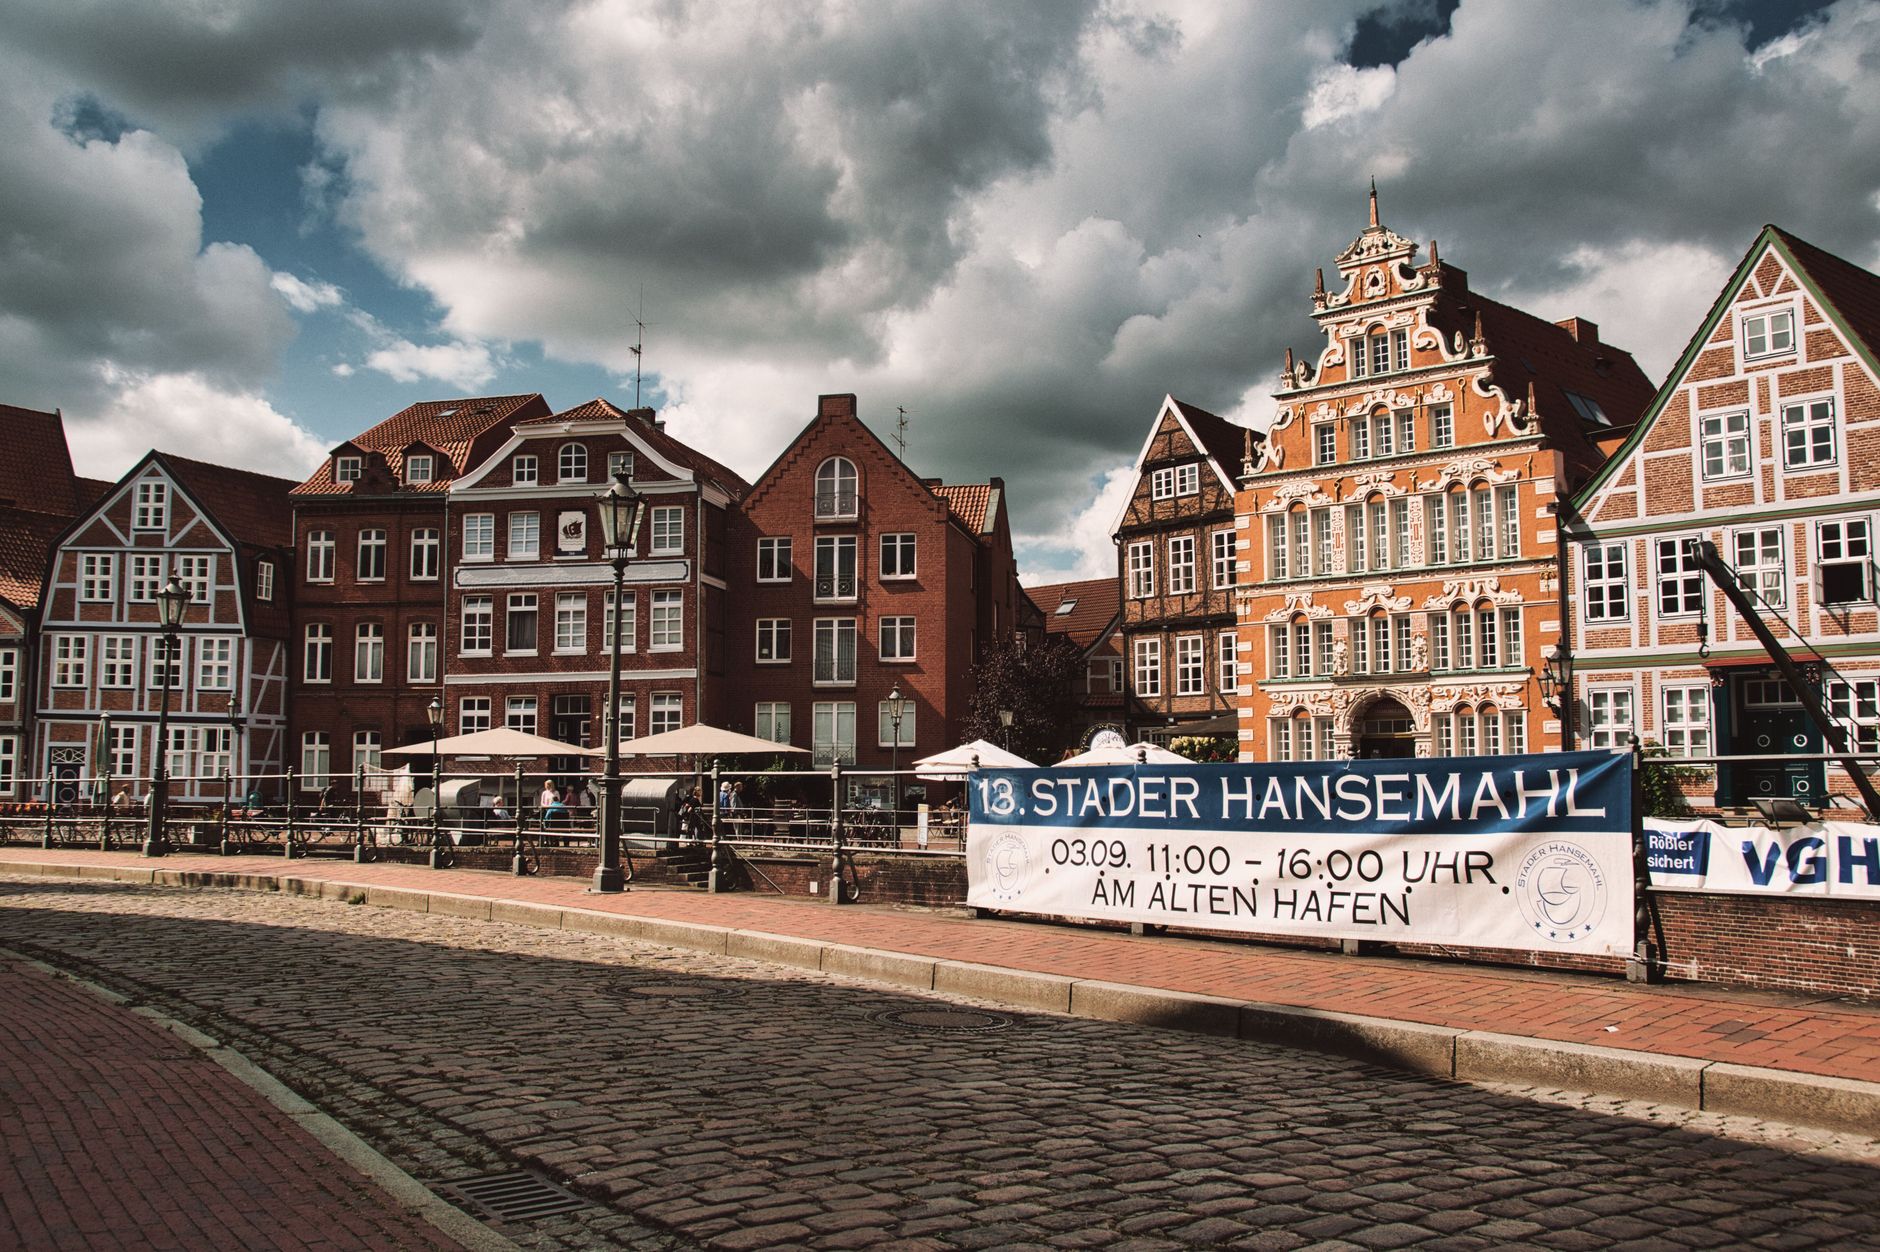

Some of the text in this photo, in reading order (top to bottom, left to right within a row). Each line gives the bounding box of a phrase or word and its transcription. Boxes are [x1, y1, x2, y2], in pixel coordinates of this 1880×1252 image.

[978, 768, 1606, 822] 13. STADER HANSEMAHL
[1051, 839, 1131, 868] 03.09.
[1147, 844, 1230, 875] 11:00
[1278, 848, 1383, 882] 16:00
[1402, 850, 1496, 884] UHR
[1517, 843, 1603, 891] STADER HANSEMAHL
[1741, 835, 1880, 886] VGH
[1091, 878, 1410, 926] AM ALTEN HAFEN
